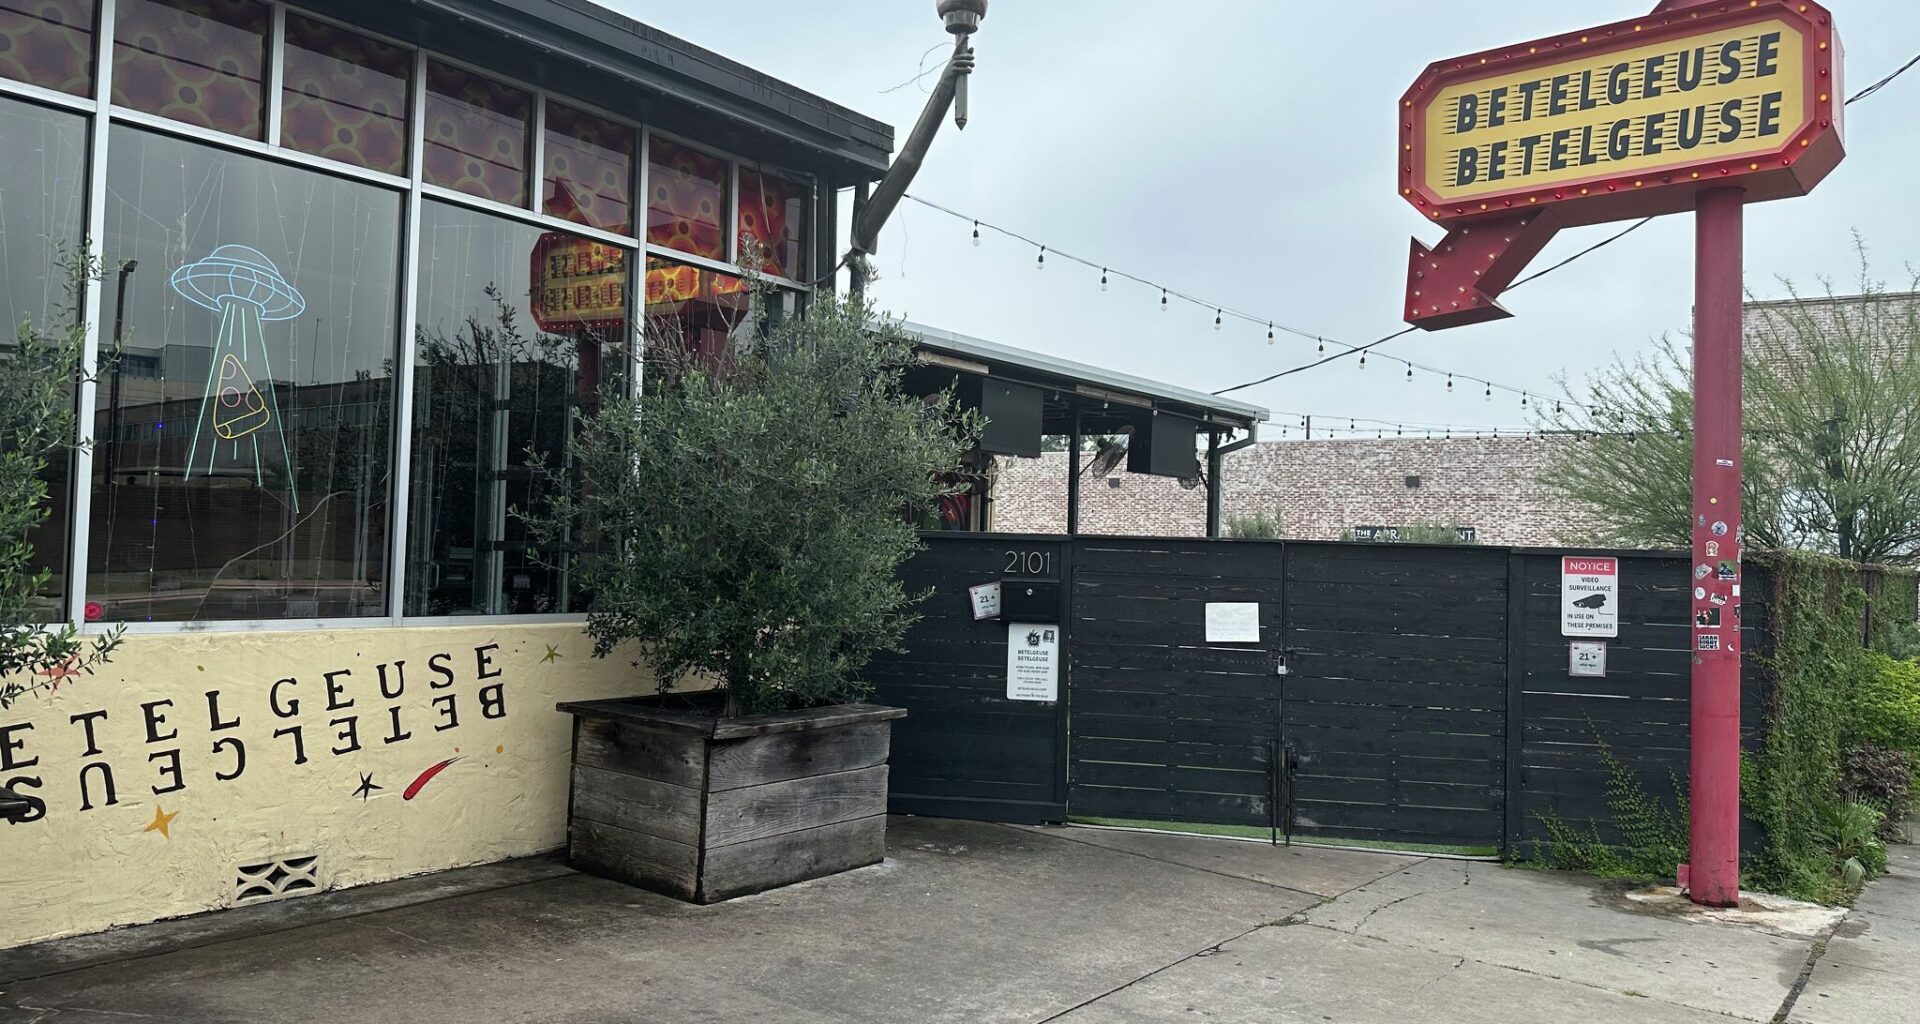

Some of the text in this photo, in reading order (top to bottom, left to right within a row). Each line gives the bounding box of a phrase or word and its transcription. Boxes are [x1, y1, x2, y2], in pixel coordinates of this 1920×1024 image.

[1454, 31, 1781, 134] BETELGEUSE
[1454, 91, 1783, 187] BETELGEUSE
[1356, 529, 1371, 537] THE
[1004, 550, 1050, 575] 2101
[1569, 561, 1611, 572] NOTICE
[1568, 584, 1612, 592] SURVEILLANCE
[980, 595, 990, 604] 21
[1585, 622, 1613, 630] PREMISES
[1579, 652, 1590, 661] 21
